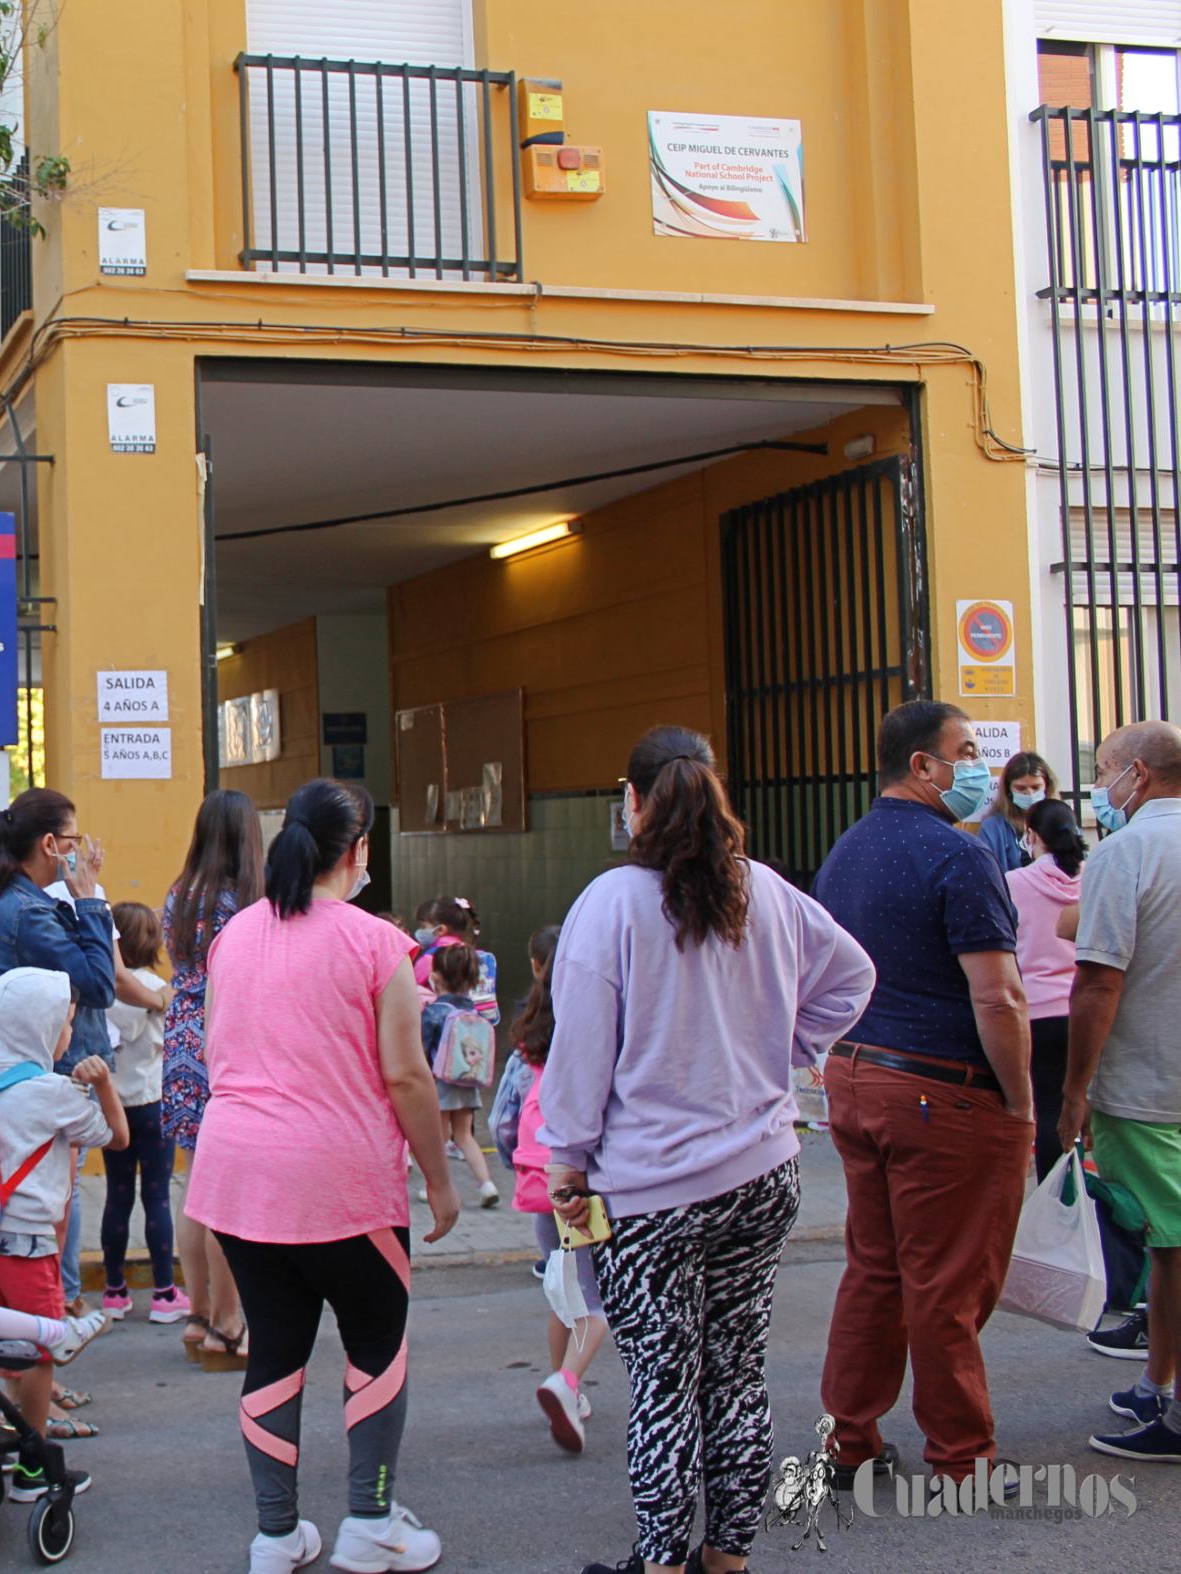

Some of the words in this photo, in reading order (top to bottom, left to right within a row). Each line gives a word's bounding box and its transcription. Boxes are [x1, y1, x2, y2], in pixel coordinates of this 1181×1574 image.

[667, 143, 687, 152] CEIP
[688, 144, 722, 154] MIGUEL
[725, 147, 737, 155] DE
[738, 147, 789, 159] CERVANTES
[694, 162, 711, 171] Part
[712, 163, 721, 171] of
[721, 163, 764, 174] Cambridge
[685, 170, 718, 179] National
[719, 171, 745, 181] School
[746, 173, 773, 184] Project
[102, 257, 145, 265] ALARMA
[106, 677, 156, 690] SALIDA
[103, 701, 111, 711] 4
[114, 699, 148, 711] AÑOS
[151, 701, 160, 711] A
[975, 727, 1009, 738] ALIDA
[104, 733, 160, 744] ENTRADA
[104, 751, 110, 760] 5
[112, 749, 140, 760] AÑOS
[142, 751, 168, 760] A,B,C
[1004, 749, 1010, 758] B
